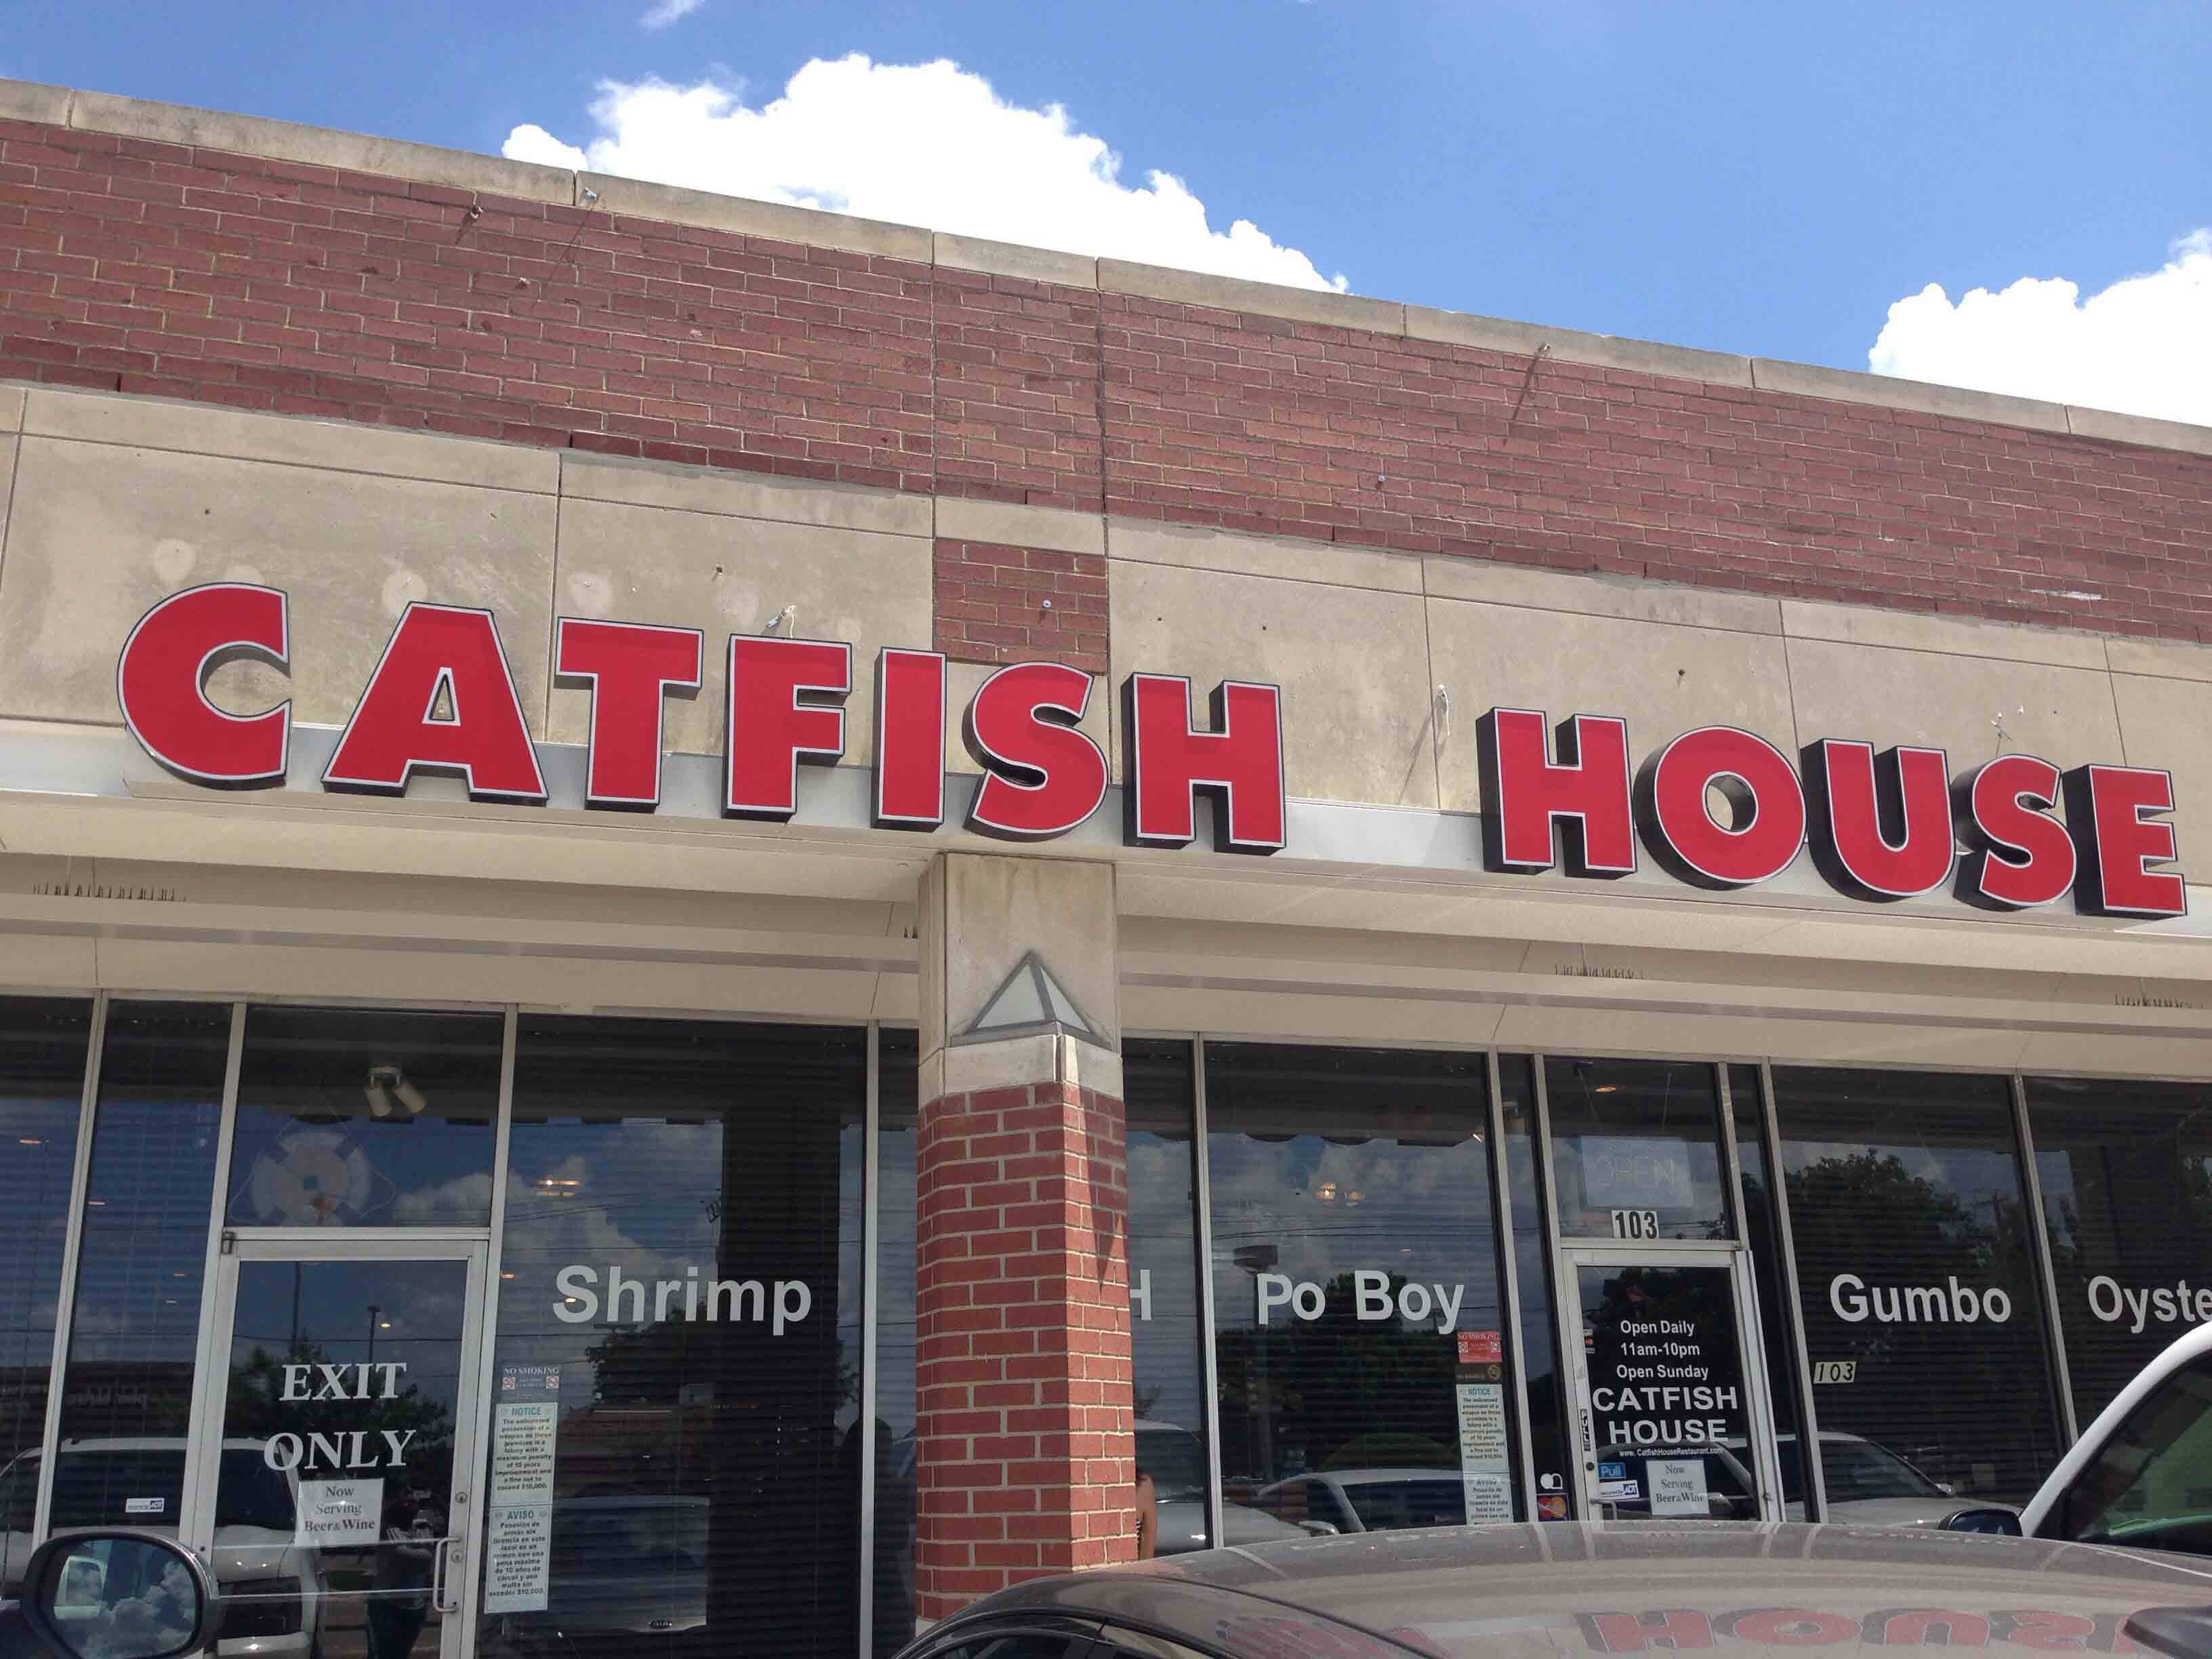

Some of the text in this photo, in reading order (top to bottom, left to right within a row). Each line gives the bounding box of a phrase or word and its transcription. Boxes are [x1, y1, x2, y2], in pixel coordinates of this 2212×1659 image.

[116, 581, 2187, 920] CATFISH HOUSE
[1615, 1210, 1658, 1240] 103
[552, 1264, 812, 1336] Shrimp
[1257, 1270, 1465, 1335] Po Boy
[1829, 1273, 2012, 1324] Gumbo
[2087, 1275, 2212, 1334] Oyste
[1620, 1319, 1696, 1337] Open Daily
[1620, 1341, 1701, 1359] 11am-10pm
[504, 1366, 559, 1376] NO SMOKING
[1616, 1364, 1710, 1381] Open Sunday
[1818, 1364, 1854, 1382] 103
[279, 1362, 407, 1401] EXIT
[1593, 1385, 1738, 1412] CATFISH
[511, 1407, 541, 1416] NOTICE
[1608, 1418, 1728, 1444] HOUSE
[264, 1429, 417, 1471] ONLY
[1600, 1465, 1622, 1477] Pull
[1664, 1464, 1686, 1475] Now
[325, 1486, 354, 1497] Now
[1624, 1483, 1638, 1495] ADT
[1660, 1479, 1694, 1491] Serving
[316, 1504, 363, 1516] Serving
[507, 1510, 535, 1519] AVISO
